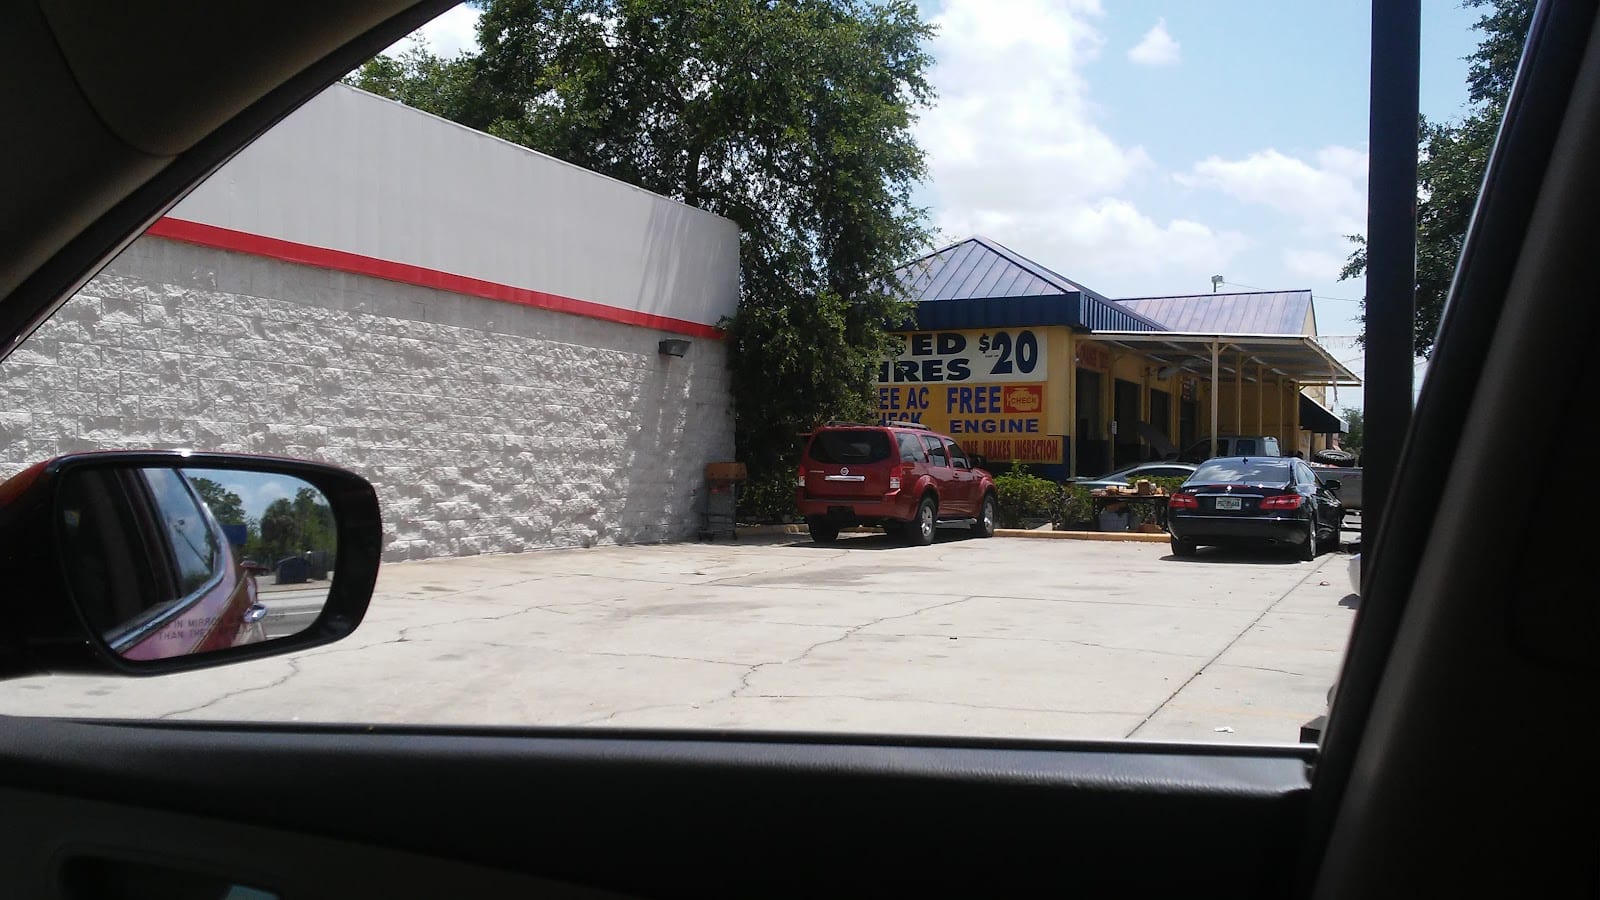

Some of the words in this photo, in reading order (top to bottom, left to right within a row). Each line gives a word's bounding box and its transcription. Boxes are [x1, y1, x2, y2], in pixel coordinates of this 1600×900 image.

[878, 359, 971, 383] IRES
[906, 387, 929, 409] AC
[947, 386, 1001, 413] FREE
[950, 419, 1039, 433] ENGINE
[983, 440, 1011, 459] BRAKES
[1015, 439, 1057, 461] INSPECTION
[158, 632, 184, 642] THAN
